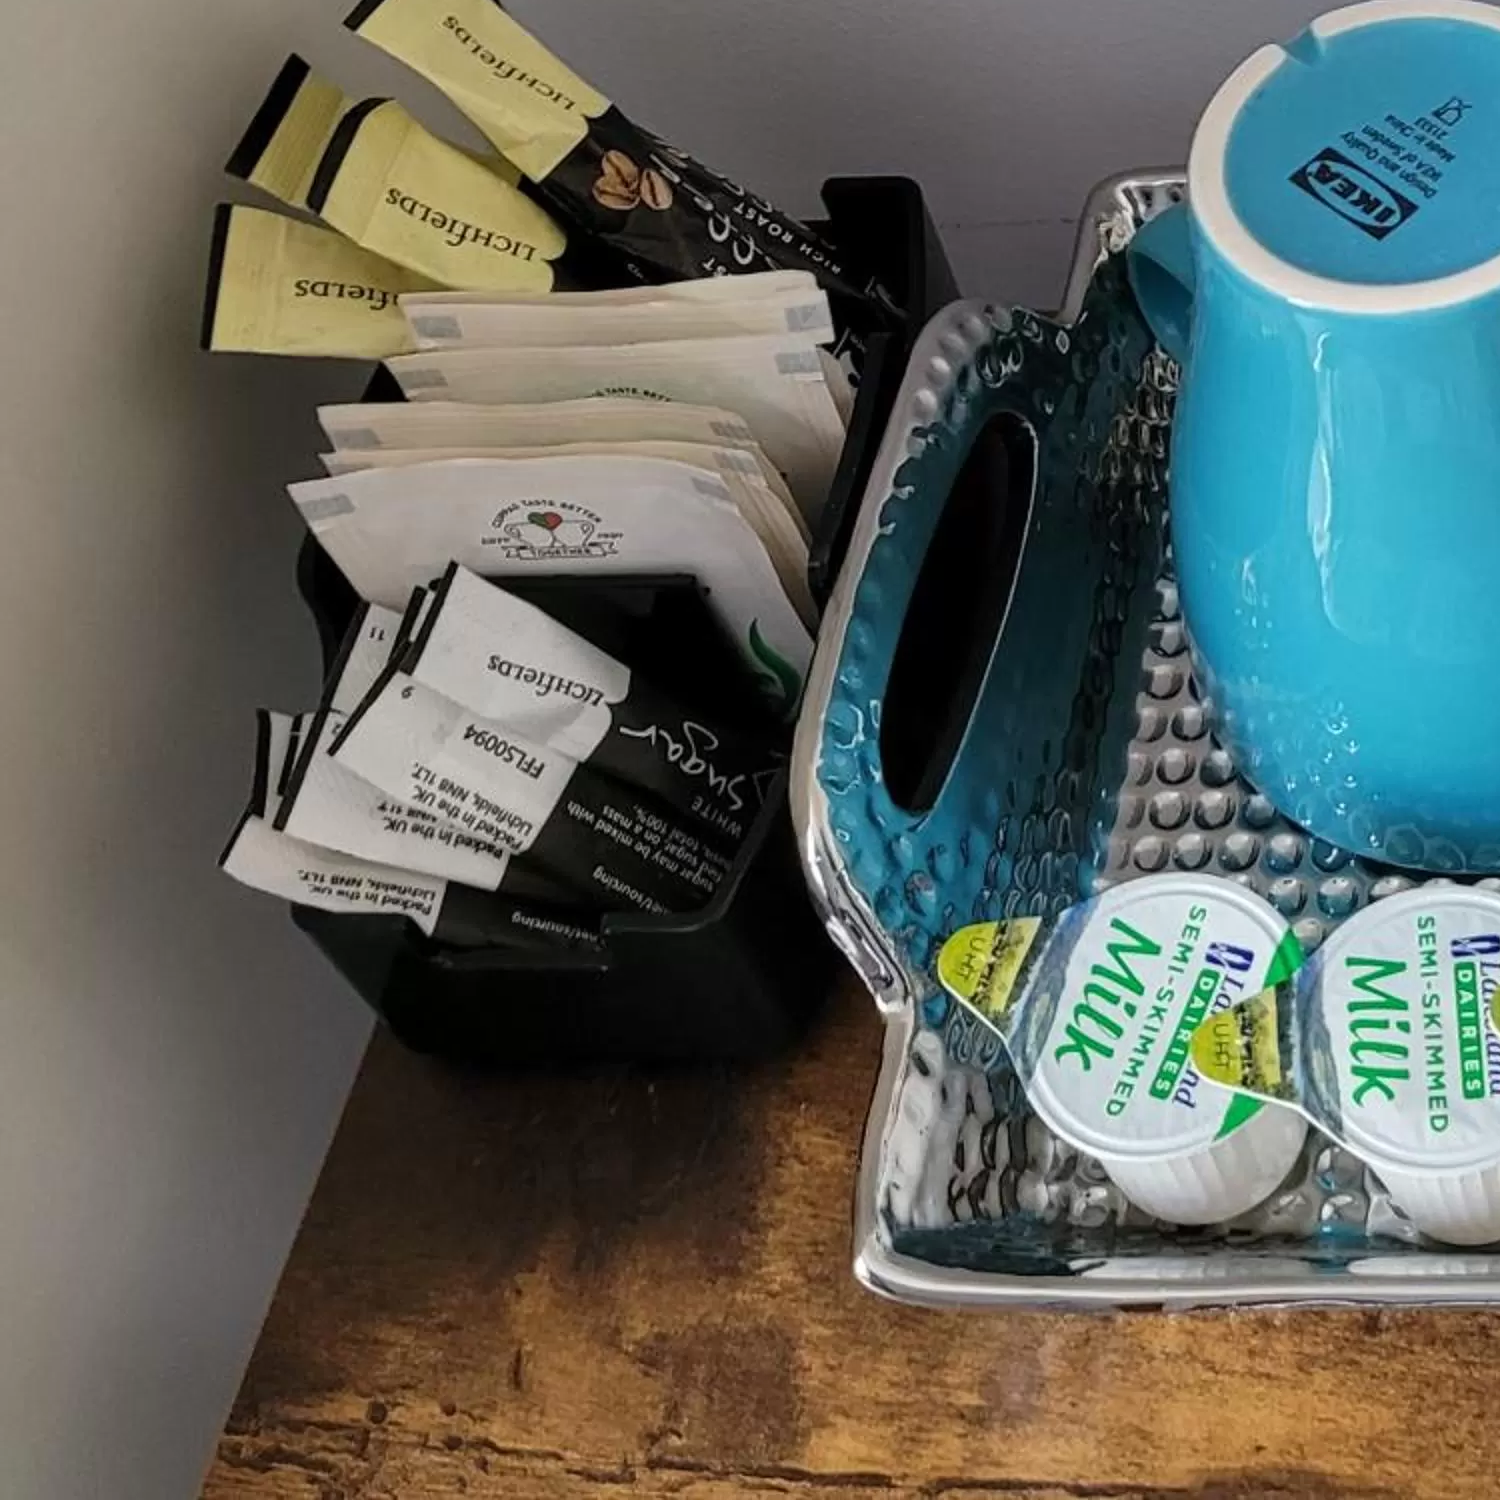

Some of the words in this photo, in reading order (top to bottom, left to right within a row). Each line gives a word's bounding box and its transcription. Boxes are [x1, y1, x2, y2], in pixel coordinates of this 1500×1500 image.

[1384, 115, 1415, 137] China
[1340, 132, 1378, 160] Quality
[1362, 125, 1406, 156] Sweden
[1425, 140, 1456, 162] Made
[1379, 156, 1401, 173] and
[1399, 153, 1418, 163] of
[1310, 162, 1398, 223] IKEA
[1400, 169, 1438, 198] Design
[733, 202, 794, 244] ROAST
[800, 243, 842, 275] RICH
[463, 724, 546, 780] FFLS0094
[438, 799, 462, 819] the
[461, 812, 476, 827] in
[568, 801, 595, 824] with
[692, 796, 742, 839] WHITE
[411, 824, 436, 840] the
[438, 830, 452, 845] in
[594, 819, 634, 847] mixed
[634, 841, 650, 859] be
[652, 851, 679, 873] may
[381, 896, 432, 915] Packed
[1054, 917, 1162, 1072] Milk
[1105, 904, 1207, 1117] SEMI-SKIMMED
[1417, 915, 1449, 1133] SEMI-SKIMMED
[1154, 975, 1212, 1092] DAIRIES
[1345, 956, 1411, 1109] Milk
[1457, 970, 1482, 1091] DAIRIES
[1212, 1023, 1230, 1069] UHT
